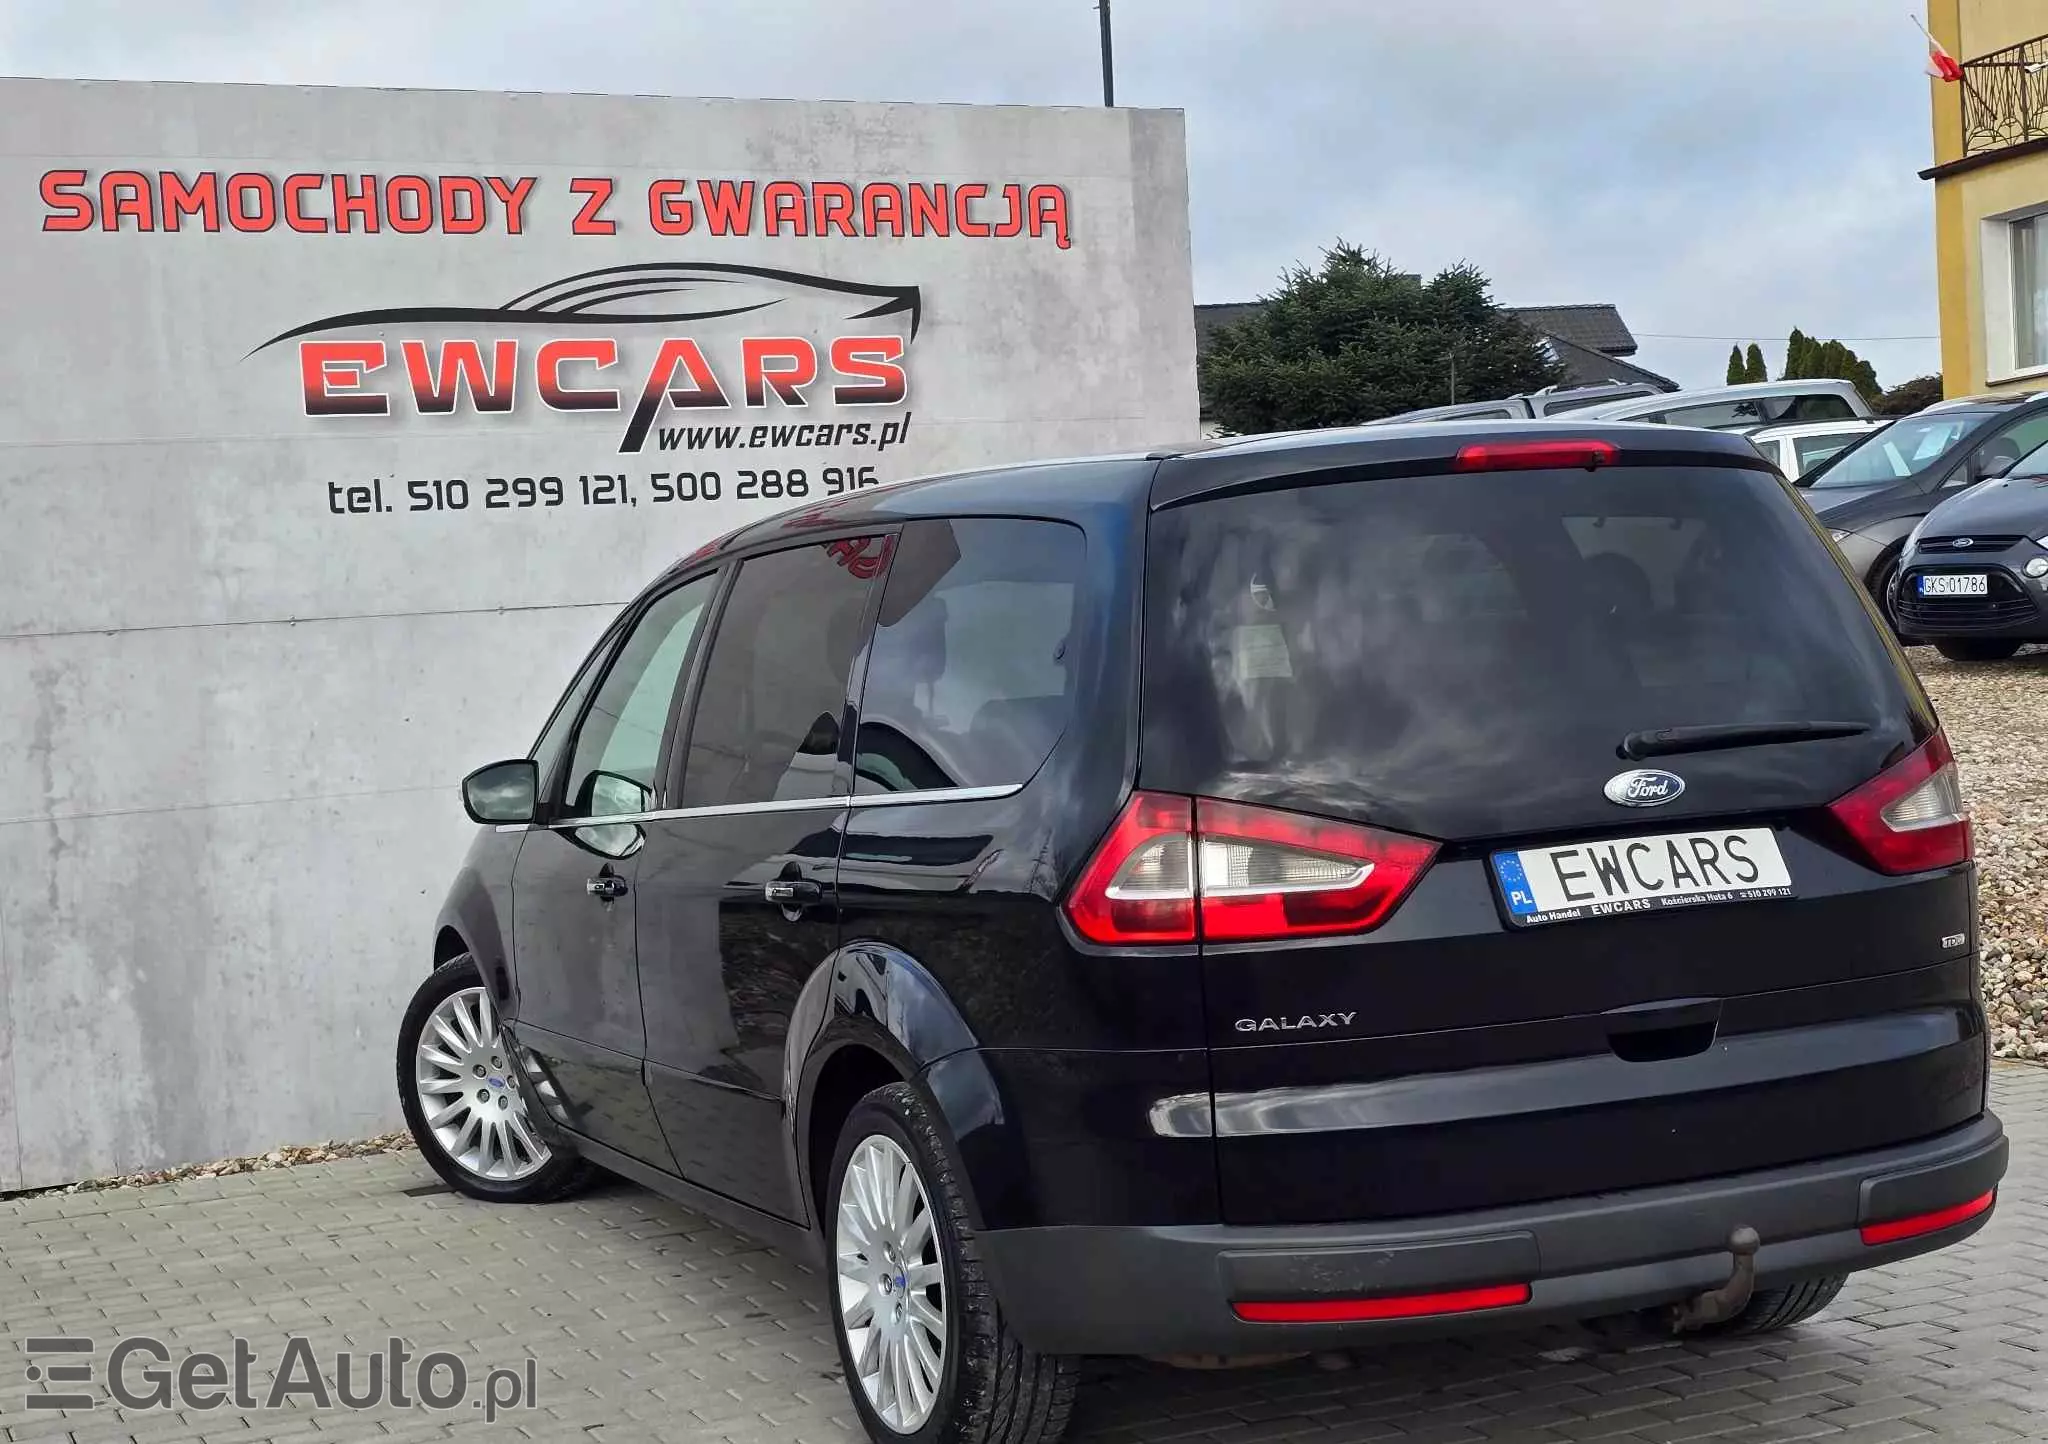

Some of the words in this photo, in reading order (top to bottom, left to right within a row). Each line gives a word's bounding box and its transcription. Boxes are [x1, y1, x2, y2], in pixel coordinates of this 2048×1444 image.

[39, 170, 538, 235] SAMOCHODY
[570, 178, 616, 236] Z
[648, 179, 1072, 249] GWARANCJĄ
[299, 336, 908, 453] EWCARS
[658, 411, 912, 451] www.ewcars.pl
[328, 479, 393, 514] tel.
[407, 479, 469, 511] 510
[485, 476, 564, 508] 299
[579, 474, 637, 507] 121,
[650, 471, 721, 503] 500
[736, 468, 809, 500] 288
[1627, 776, 1669, 798] Ford
[1550, 835, 1759, 901] EWCARS
[1511, 890, 1533, 906] PL
[1526, 913, 1549, 924] Auto
[1550, 908, 1582, 921] Handel
[1591, 898, 1651, 915] EWCARS
[1707, 892, 1727, 902] Huta
[1727, 891, 1734, 900] 6
[1778, 887, 1792, 896] 121
[1234, 1011, 1358, 1032] GALAXY
